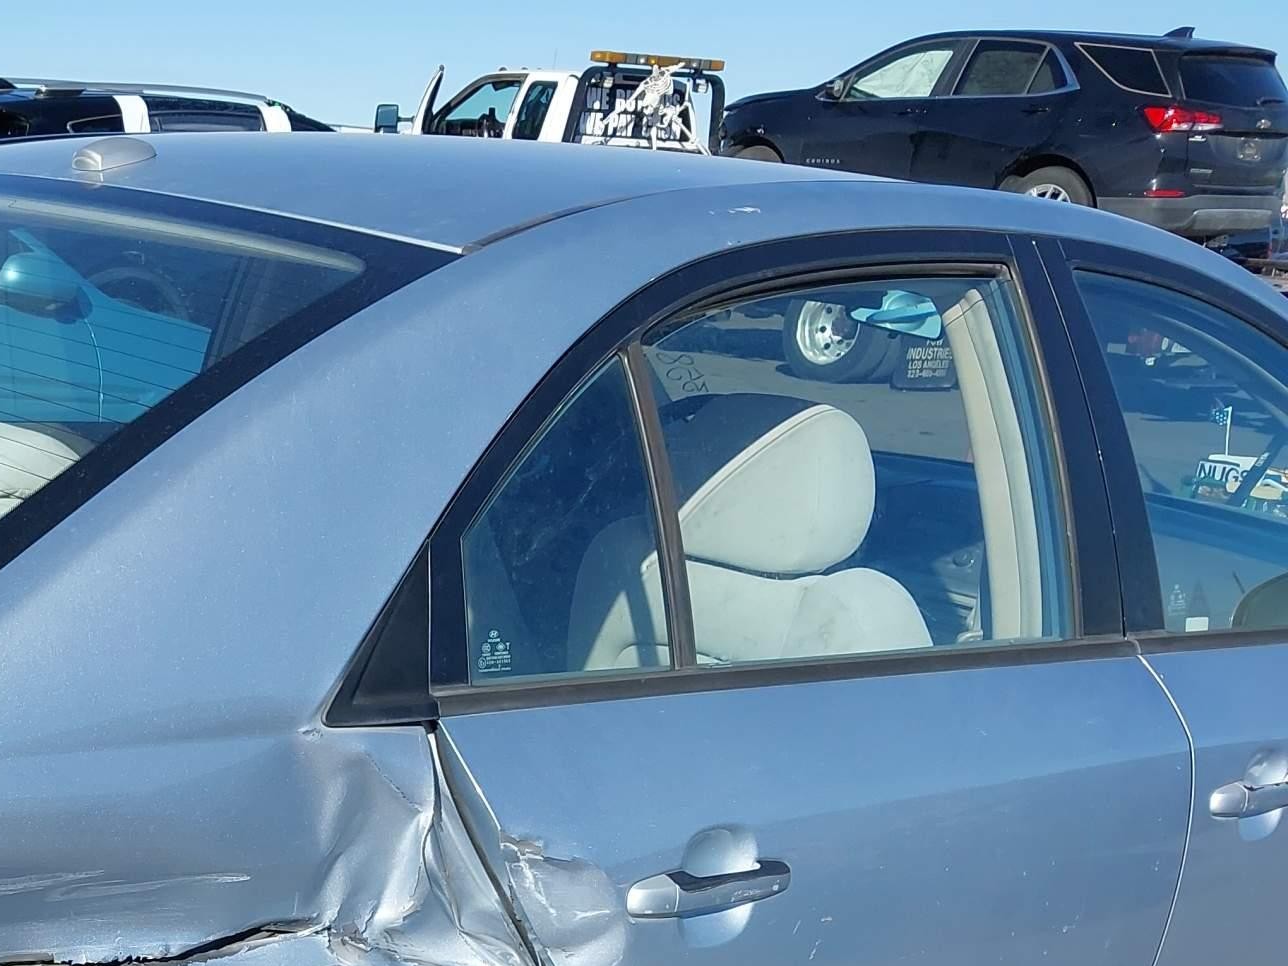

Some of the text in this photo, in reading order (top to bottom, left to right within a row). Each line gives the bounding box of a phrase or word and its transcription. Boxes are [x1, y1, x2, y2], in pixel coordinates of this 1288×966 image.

[586, 87, 609, 110] WE
[580, 112, 603, 136] WE
[608, 112, 635, 137] PAY
[908, 361, 922, 369] LOS
